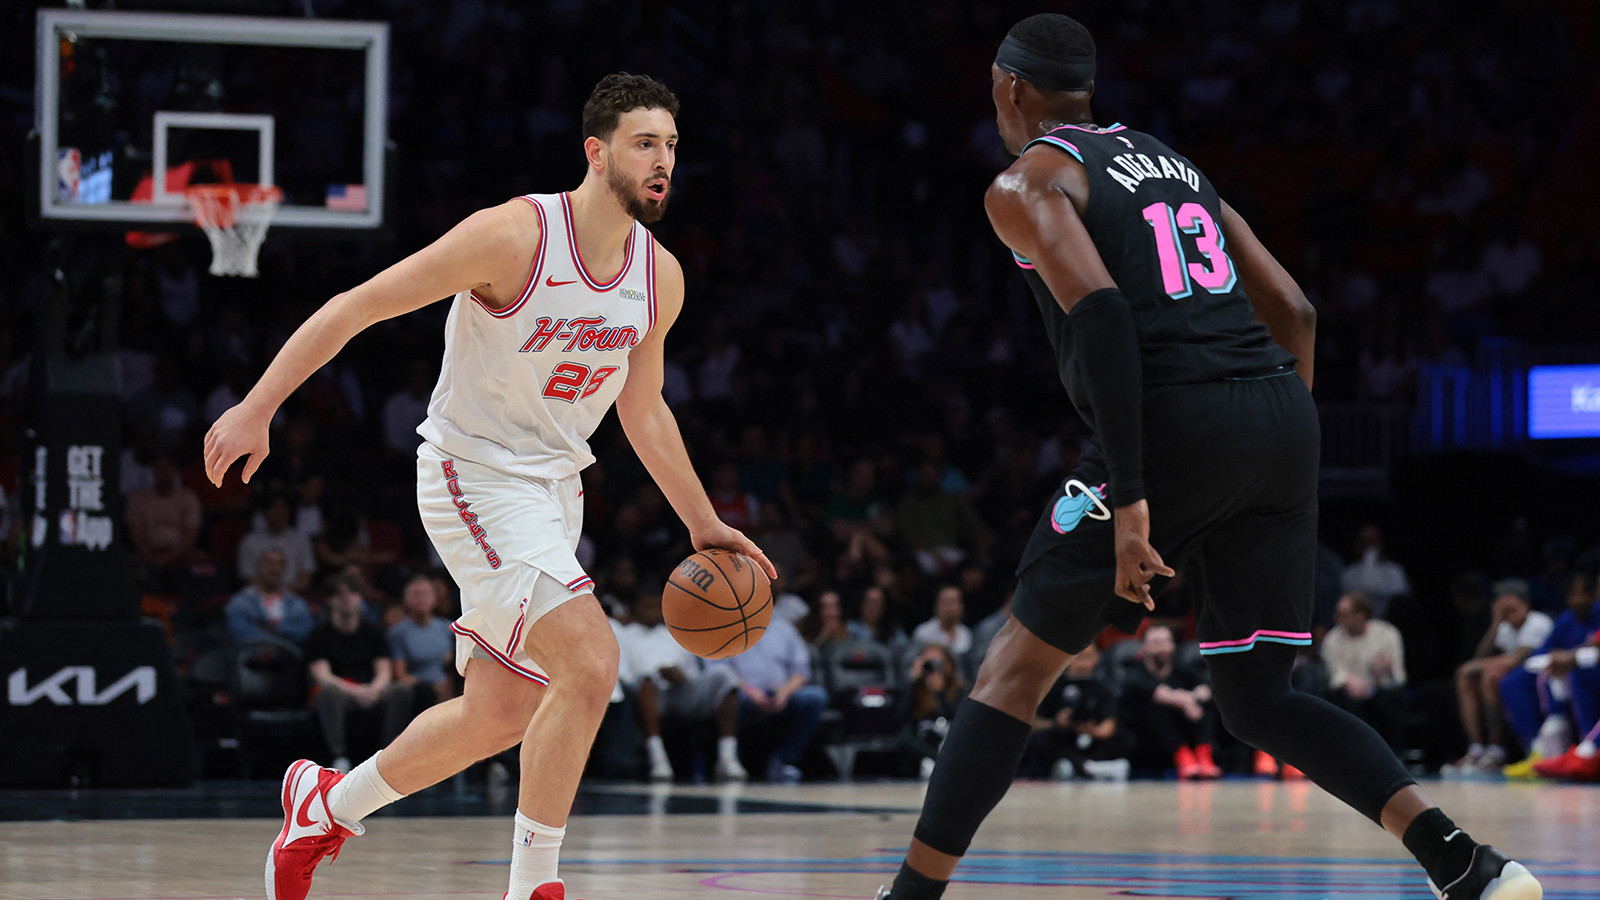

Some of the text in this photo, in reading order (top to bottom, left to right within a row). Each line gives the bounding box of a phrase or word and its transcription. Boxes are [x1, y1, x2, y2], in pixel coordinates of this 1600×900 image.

[1105, 153, 1200, 194] ADEBAYO
[1141, 202, 1238, 301] 13
[518, 316, 640, 352] H-Town
[541, 361, 620, 404] 28
[440, 459, 502, 570] ROCKETS
